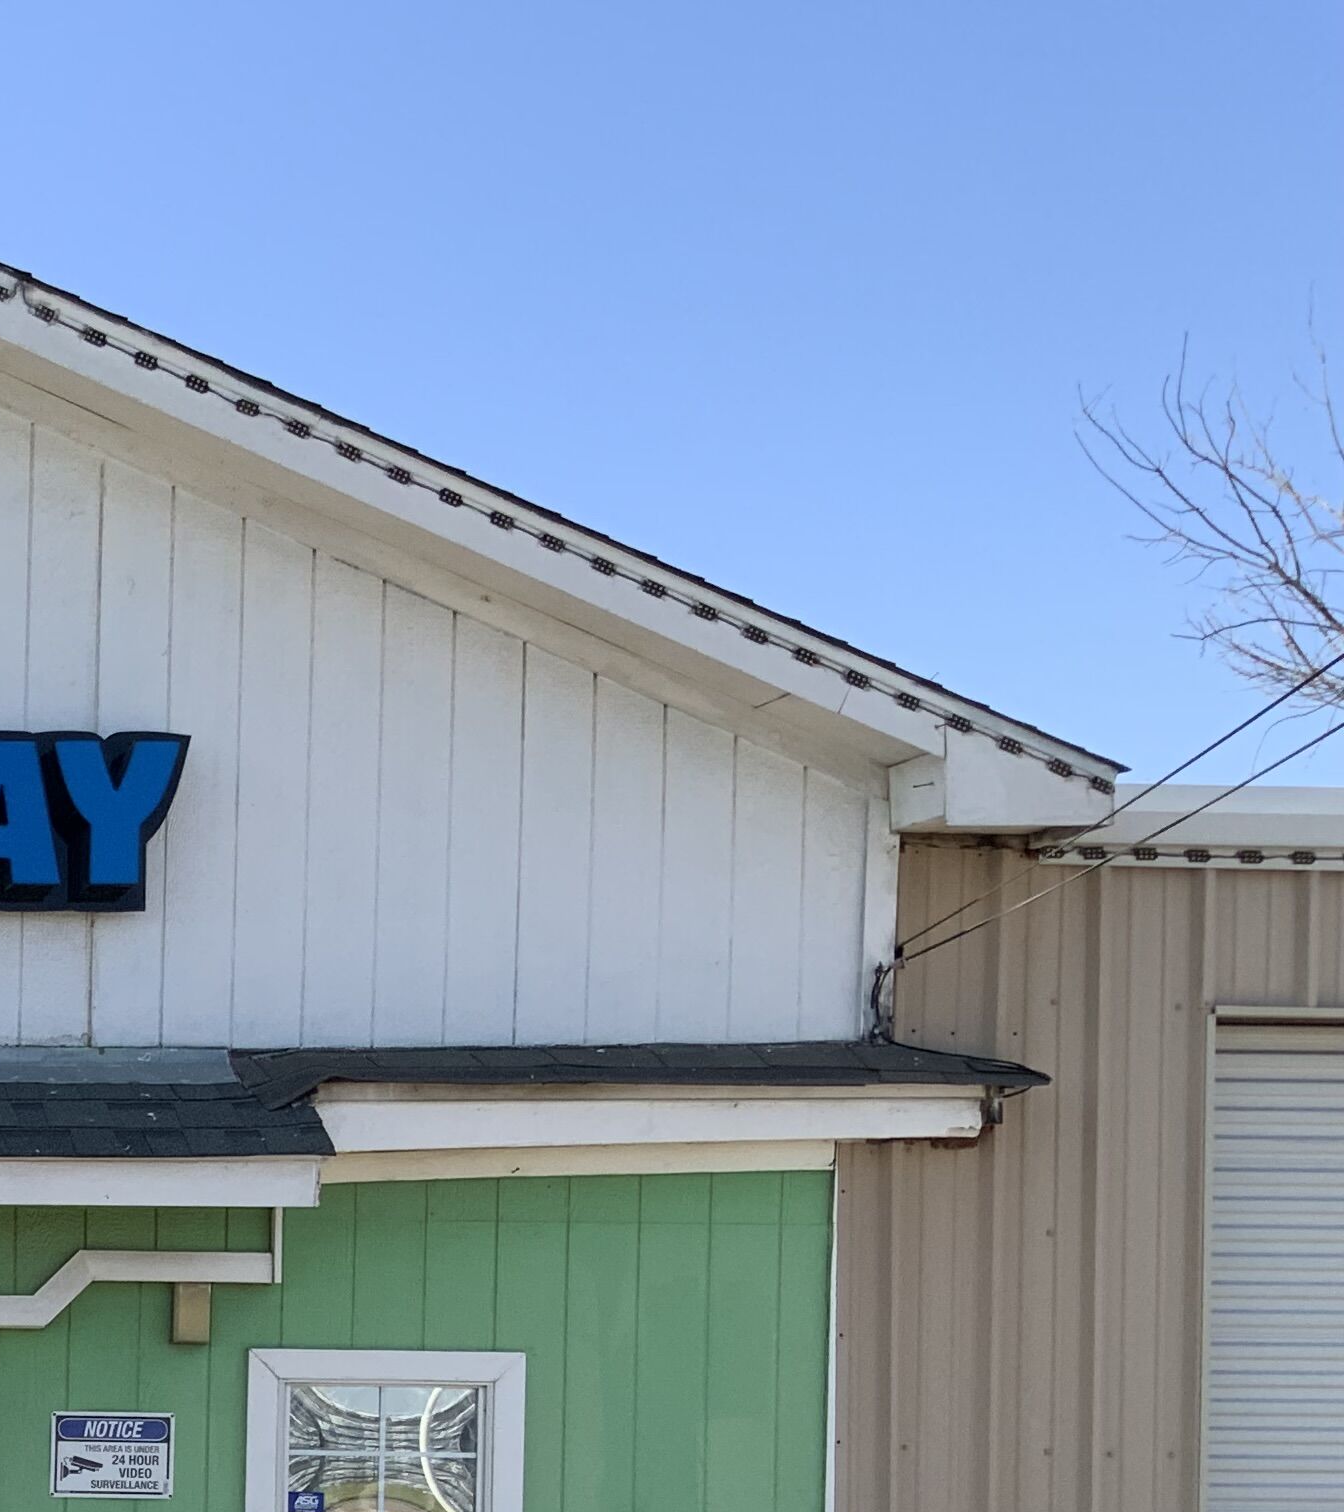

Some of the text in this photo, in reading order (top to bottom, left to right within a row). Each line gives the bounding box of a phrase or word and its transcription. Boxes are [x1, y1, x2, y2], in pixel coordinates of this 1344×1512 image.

[83, 1420, 144, 1438] NOTICE
[84, 1444, 160, 1454] THIS AREA IS UNDER
[111, 1454, 160, 1466] 24 HOUR
[118, 1467, 153, 1479] VIDEO
[90, 1479, 159, 1490] SURVEILLANCE
